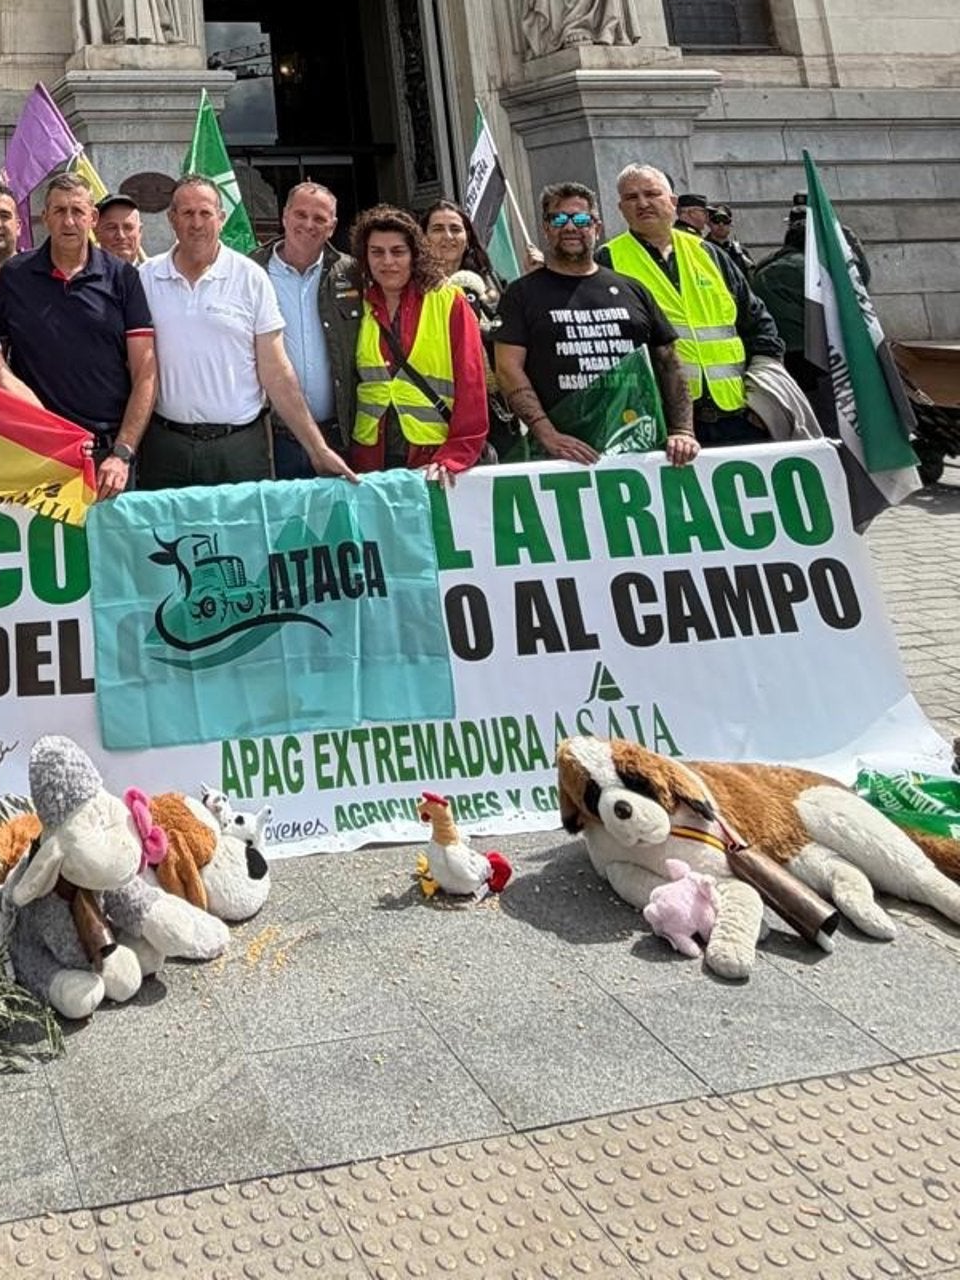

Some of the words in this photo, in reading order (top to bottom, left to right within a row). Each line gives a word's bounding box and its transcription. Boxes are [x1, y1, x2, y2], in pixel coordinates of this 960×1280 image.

[549, 309, 574, 323] TUVE
[574, 309, 592, 324] QUE
[592, 307, 630, 322] VENDER
[565, 325, 577, 339] EL
[577, 323, 622, 339] TRACTOR
[555, 340, 593, 356] PORQUE
[593, 340, 608, 354] NO
[578, 356, 609, 372] PAGAR
[492, 456, 835, 568] ATRACO
[267, 540, 389, 612] ATACA
[514, 577, 601, 657] AL
[610, 556, 863, 648] CAMPO
[220, 733, 305, 799] APAG
[314, 713, 553, 791] EXTREMADURA
[264, 817, 329, 842] óvenes
[334, 791, 506, 833] AGRICUORES
[506, 788, 522, 813] Y
